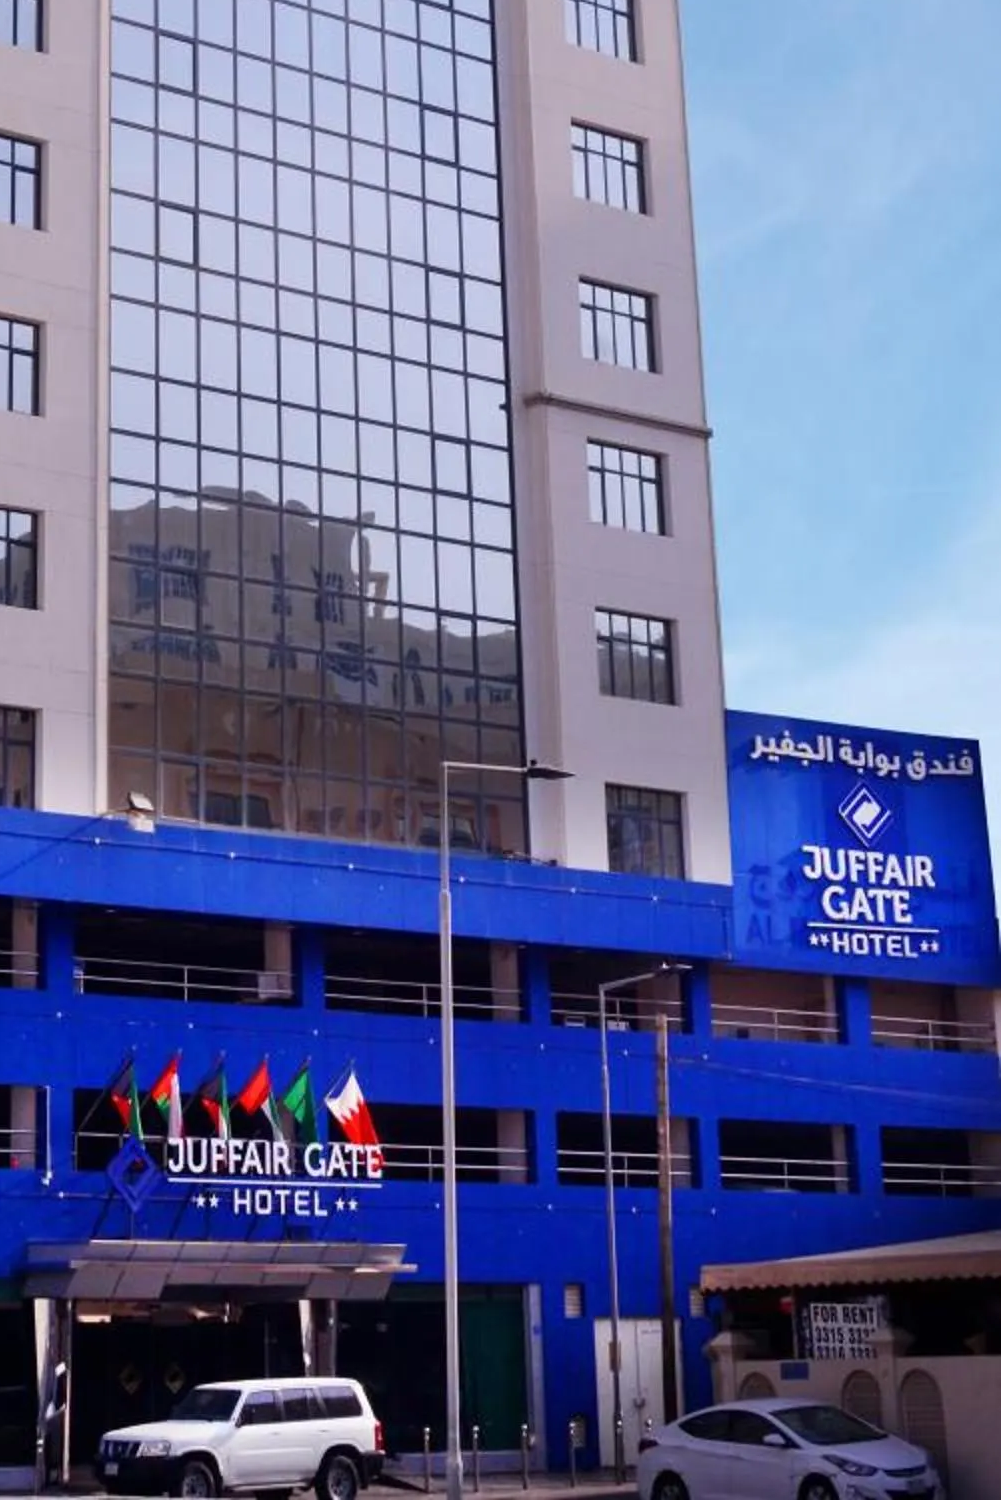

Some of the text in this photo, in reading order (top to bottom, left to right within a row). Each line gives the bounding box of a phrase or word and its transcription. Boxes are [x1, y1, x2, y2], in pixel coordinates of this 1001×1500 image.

[750, 730, 975, 781] فندق بوابة الجفير
[802, 845, 936, 888] JUFFAIR
[821, 885, 913, 924] GATE
[832, 930, 919, 958] HOTEL
[167, 1137, 383, 1179] JUFFAIR GATE
[233, 1187, 329, 1217] HOTEL
[813, 1305, 875, 1325] FOR RENT
